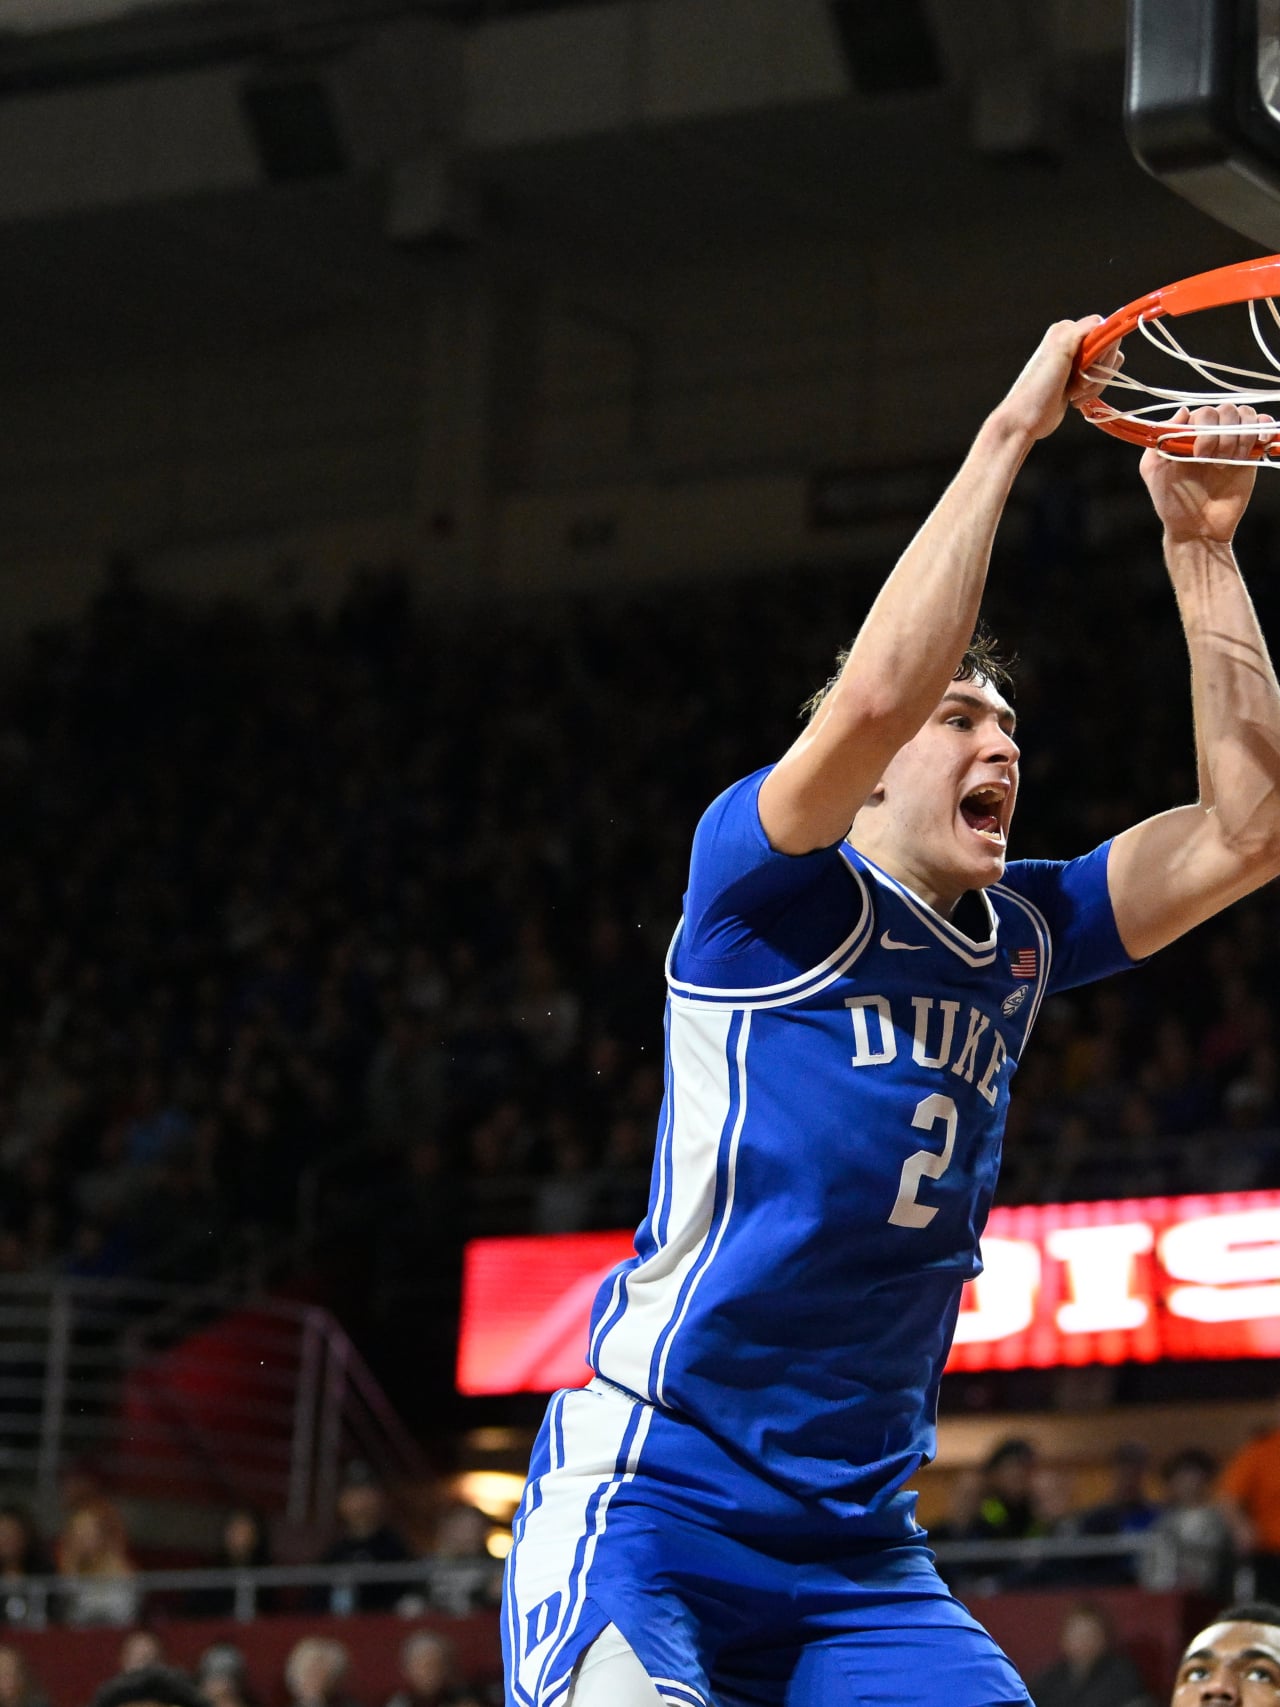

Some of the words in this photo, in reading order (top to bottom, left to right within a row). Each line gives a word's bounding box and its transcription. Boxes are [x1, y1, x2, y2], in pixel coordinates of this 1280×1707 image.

[844, 995, 1007, 1107] DUKE
[887, 1093, 958, 1228] 2
[525, 1591, 563, 1660] D
